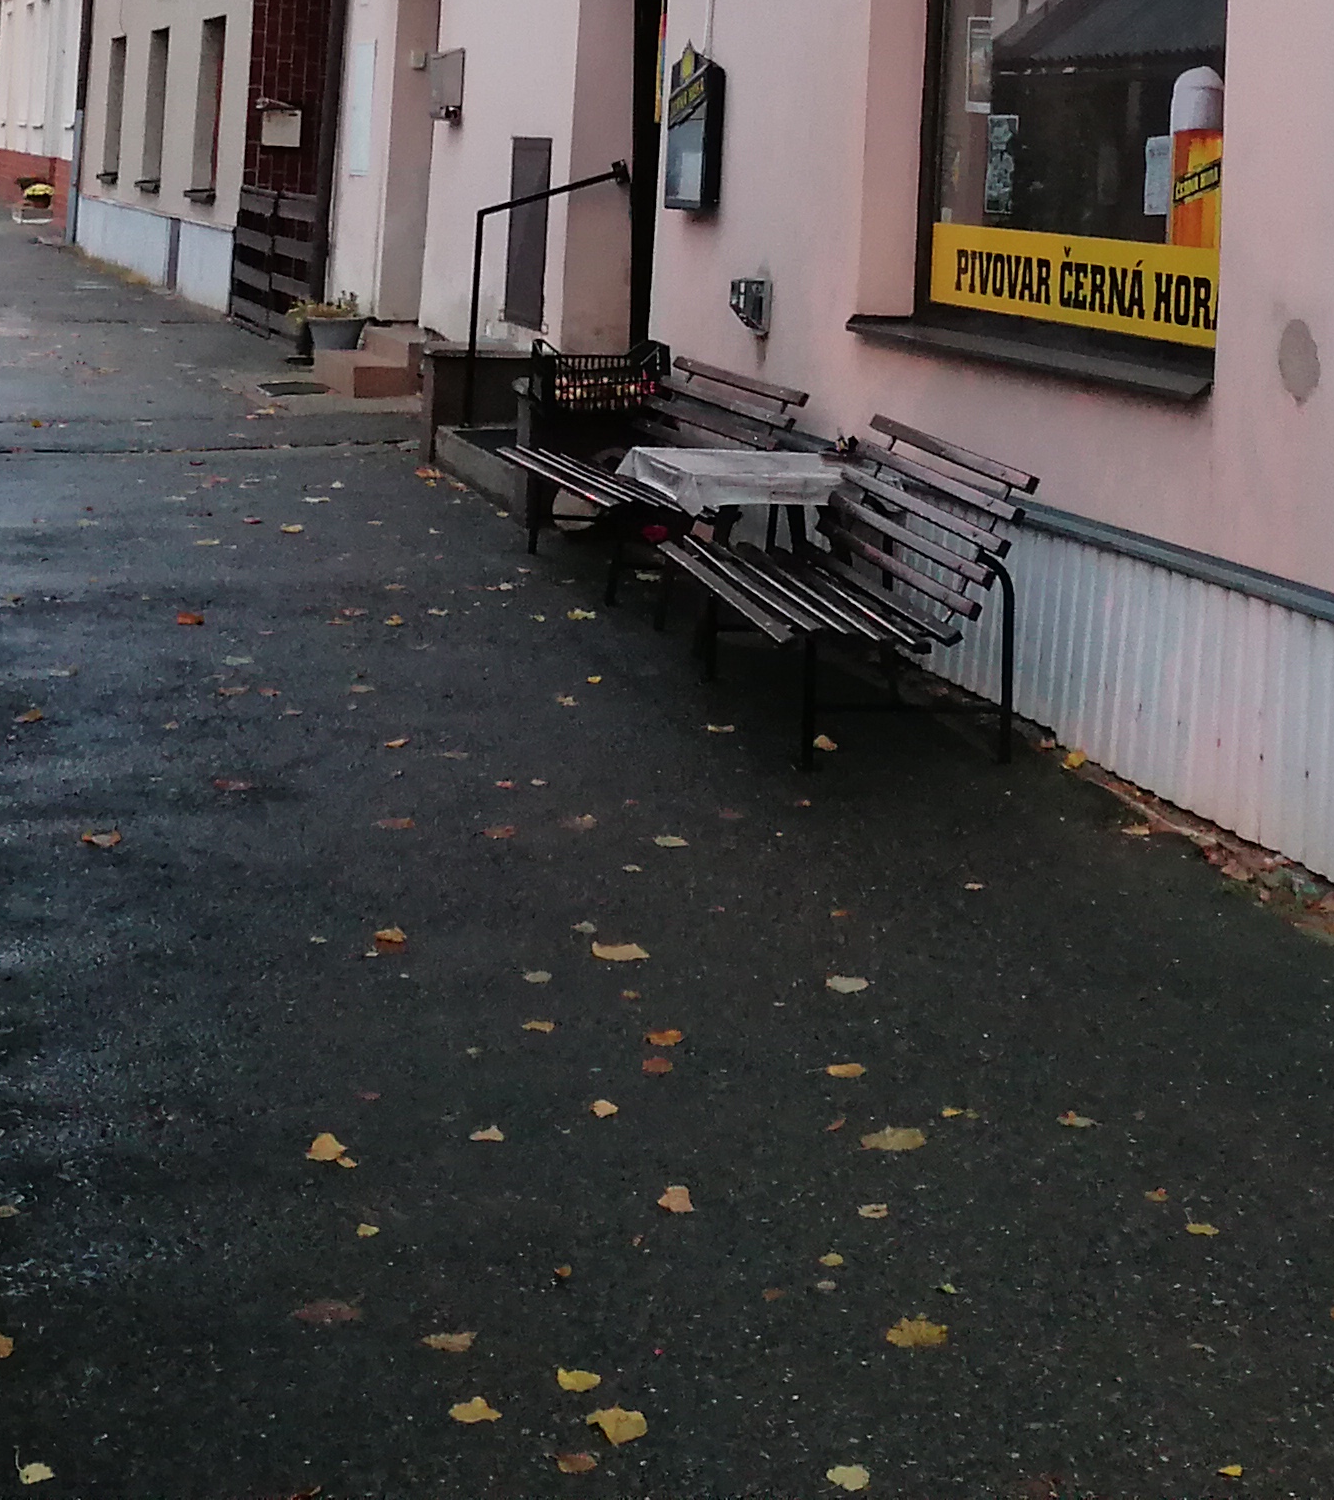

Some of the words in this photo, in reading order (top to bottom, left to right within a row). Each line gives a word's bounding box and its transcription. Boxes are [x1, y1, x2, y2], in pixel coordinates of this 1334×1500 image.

[955, 248, 1052, 306] PIVOVAR
[1059, 246, 1145, 320] ČERNÁ
[1153, 271, 1217, 331] HOR
